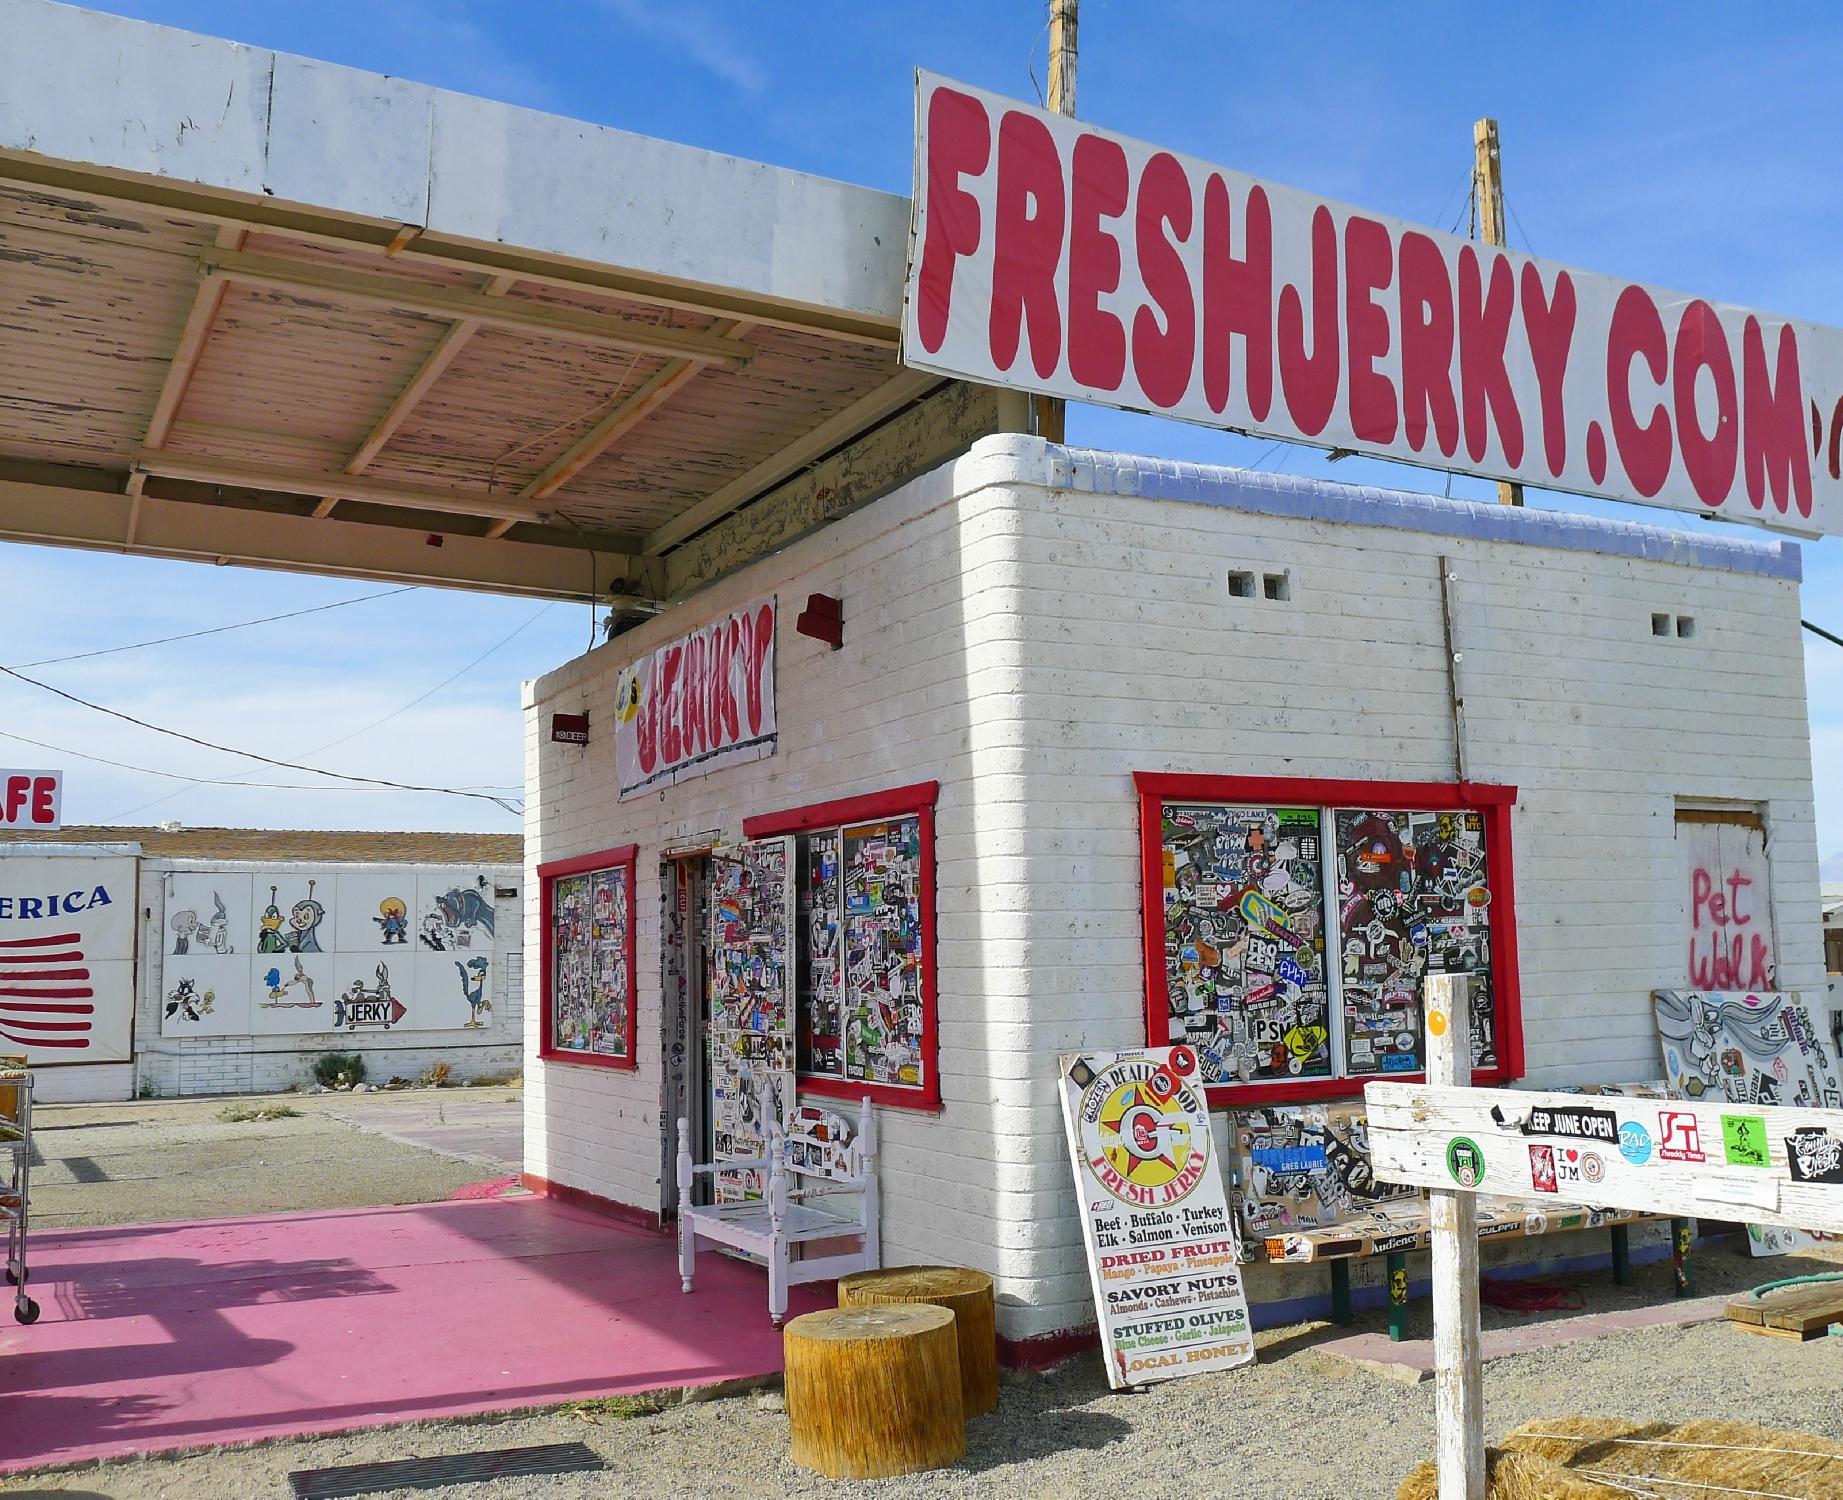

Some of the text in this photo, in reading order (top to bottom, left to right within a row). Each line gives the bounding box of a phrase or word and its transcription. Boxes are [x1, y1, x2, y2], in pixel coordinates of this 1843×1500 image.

[917, 86, 1812, 519] FRESHJERKY.COM
[637, 603, 773, 774] JERKY
[0, 775, 56, 823] FE
[1692, 867, 1752, 930] Pet
[347, 1003, 391, 1021] JERKY
[1553, 1113, 1581, 1135] JUNE
[1581, 1115, 1614, 1138] OPEN
[1617, 1130, 1650, 1150] RAD
[1281, 1160, 1324, 1171] GREG LAURIE
[1557, 1148, 1566, 1162] I
[1091, 1147, 1205, 1204] FRESH JERKY
[1558, 1165, 1580, 1181] JM
[1094, 1206, 1224, 1232] Beef Buffalo Turkey
[1098, 1221, 1228, 1248] Elk Salmon Venison
[1372, 1234, 1418, 1253] Audience
[1101, 1240, 1230, 1269] DRIED FRUIT
[1103, 1253, 1233, 1280] Mango Papaya Pineapple
[1107, 1274, 1237, 1303] SAVORY NUTS
[1110, 1288, 1240, 1316] Almonds Cashews Pistachios
[1113, 1309, 1245, 1339] STUFFED OLIVES
[1115, 1321, 1246, 1351] Blue Cheese Garlic Jalapeño
[1187, 1342, 1249, 1362] HONEY
